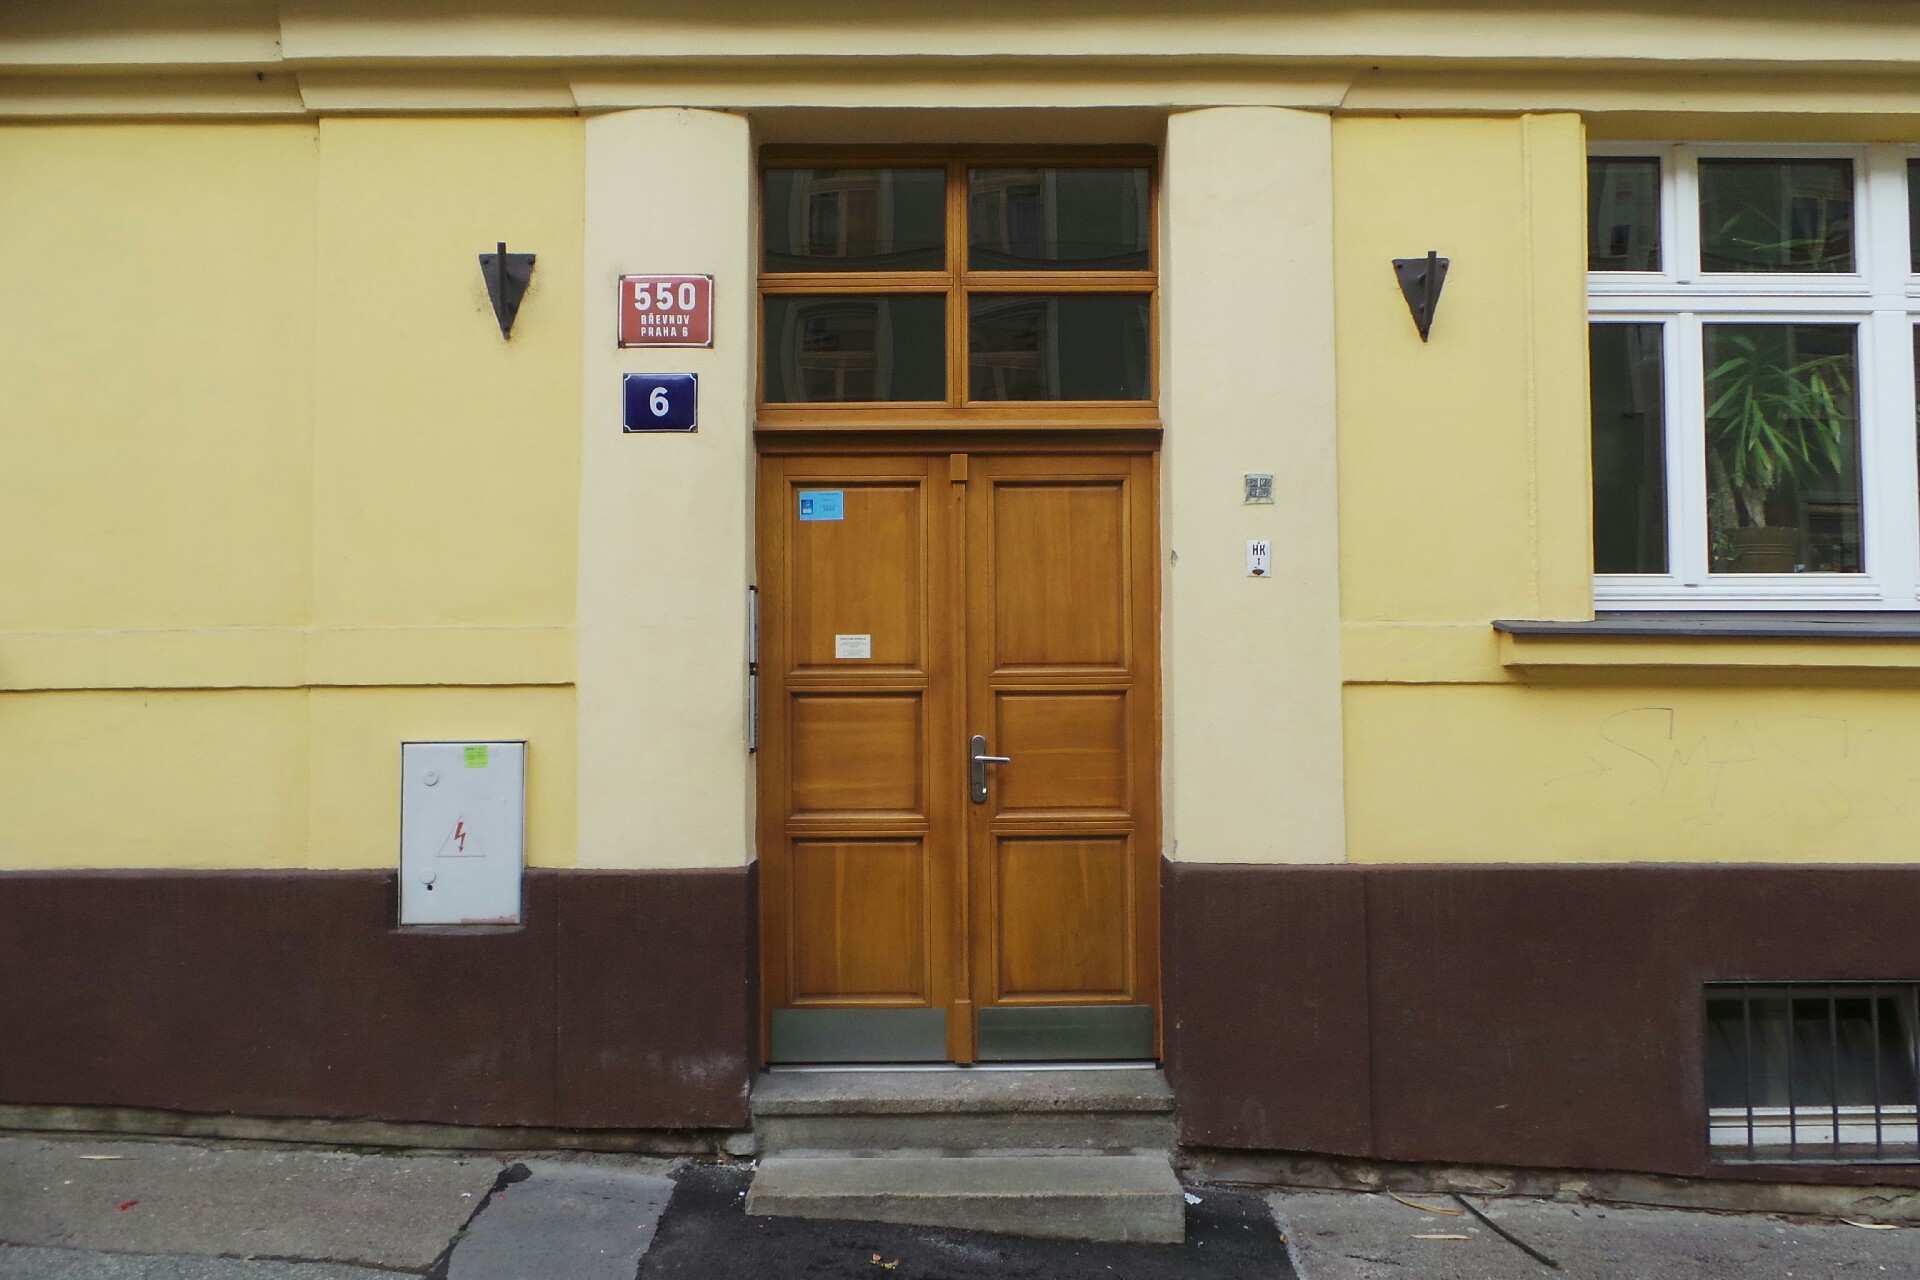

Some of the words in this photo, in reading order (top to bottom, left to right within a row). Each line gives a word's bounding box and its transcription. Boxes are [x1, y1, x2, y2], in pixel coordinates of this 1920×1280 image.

[634, 282, 696, 311] 550
[641, 312, 690, 325] BŘEVNOV
[641, 327, 677, 337] PRAHA
[682, 327, 689, 337] 6
[649, 387, 669, 417] 6
[1252, 544, 1266, 556] HK
